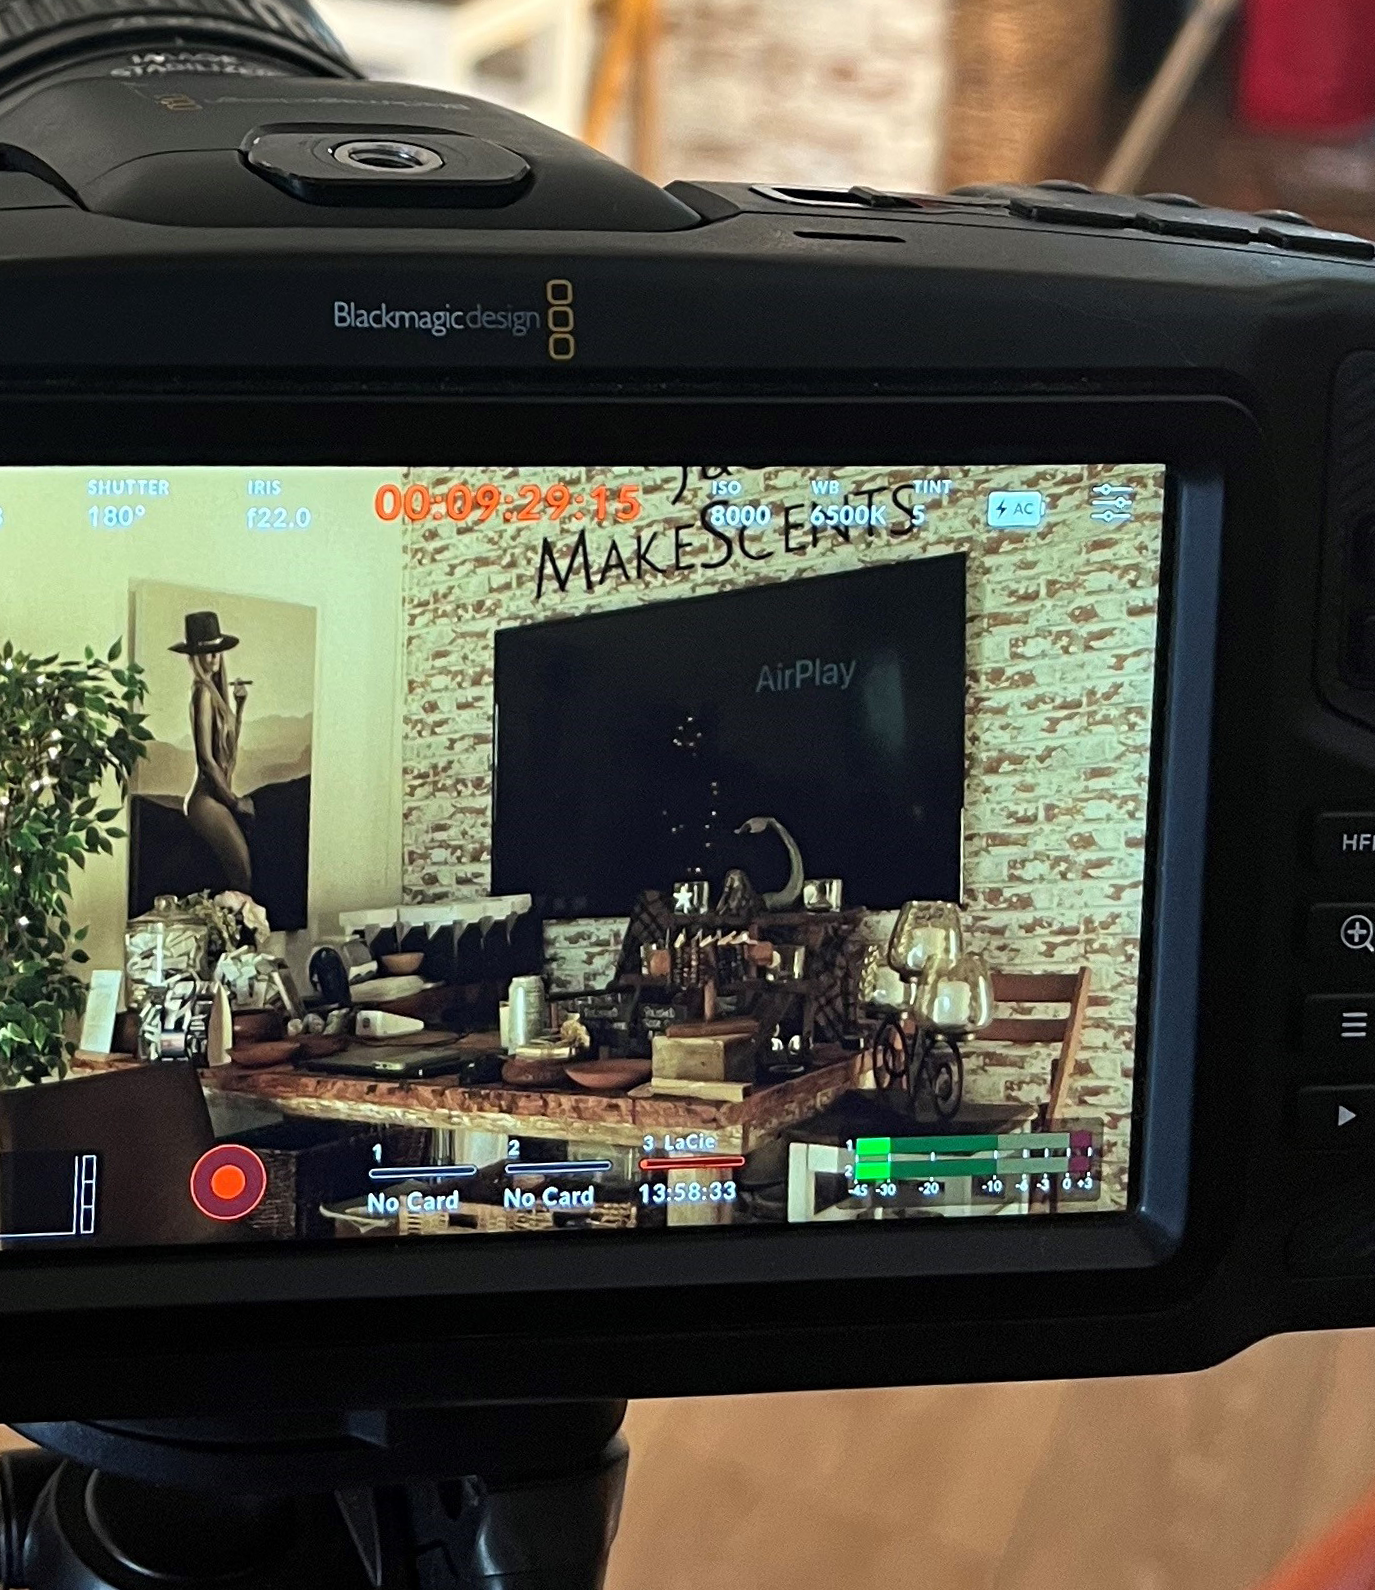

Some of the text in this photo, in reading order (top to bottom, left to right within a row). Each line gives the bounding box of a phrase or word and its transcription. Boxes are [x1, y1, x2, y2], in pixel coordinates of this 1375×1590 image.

[86, 479, 170, 496] SHUTTER
[246, 479, 282, 496] IRIS
[711, 480, 742, 495] ISO
[811, 479, 840, 495] WB
[912, 479, 952, 494] TINT
[374, 483, 642, 522] 00:09:29:15
[1013, 501, 1034, 516] AC
[246, 506, 312, 529] f22.0
[710, 504, 771, 527] 8000
[810, 504, 886, 527] 6500K
[911, 505, 925, 527] 5
[756, 658, 857, 692] AirPlay
[1343, 834, 1375, 851] HF
[372, 1143, 382, 1161] 1
[508, 1139, 521, 1157] 2
[642, 1134, 716, 1151] 3 LaCie
[638, 1181, 737, 1204] 13:58:33
[875, 1183, 898, 1197] -30
[918, 1181, 941, 1196] -20
[981, 1179, 1003, 1193] -10
[1062, 1176, 1072, 1191] 0
[367, 1191, 460, 1213] No Card
[503, 1185, 595, 1210] No Card
